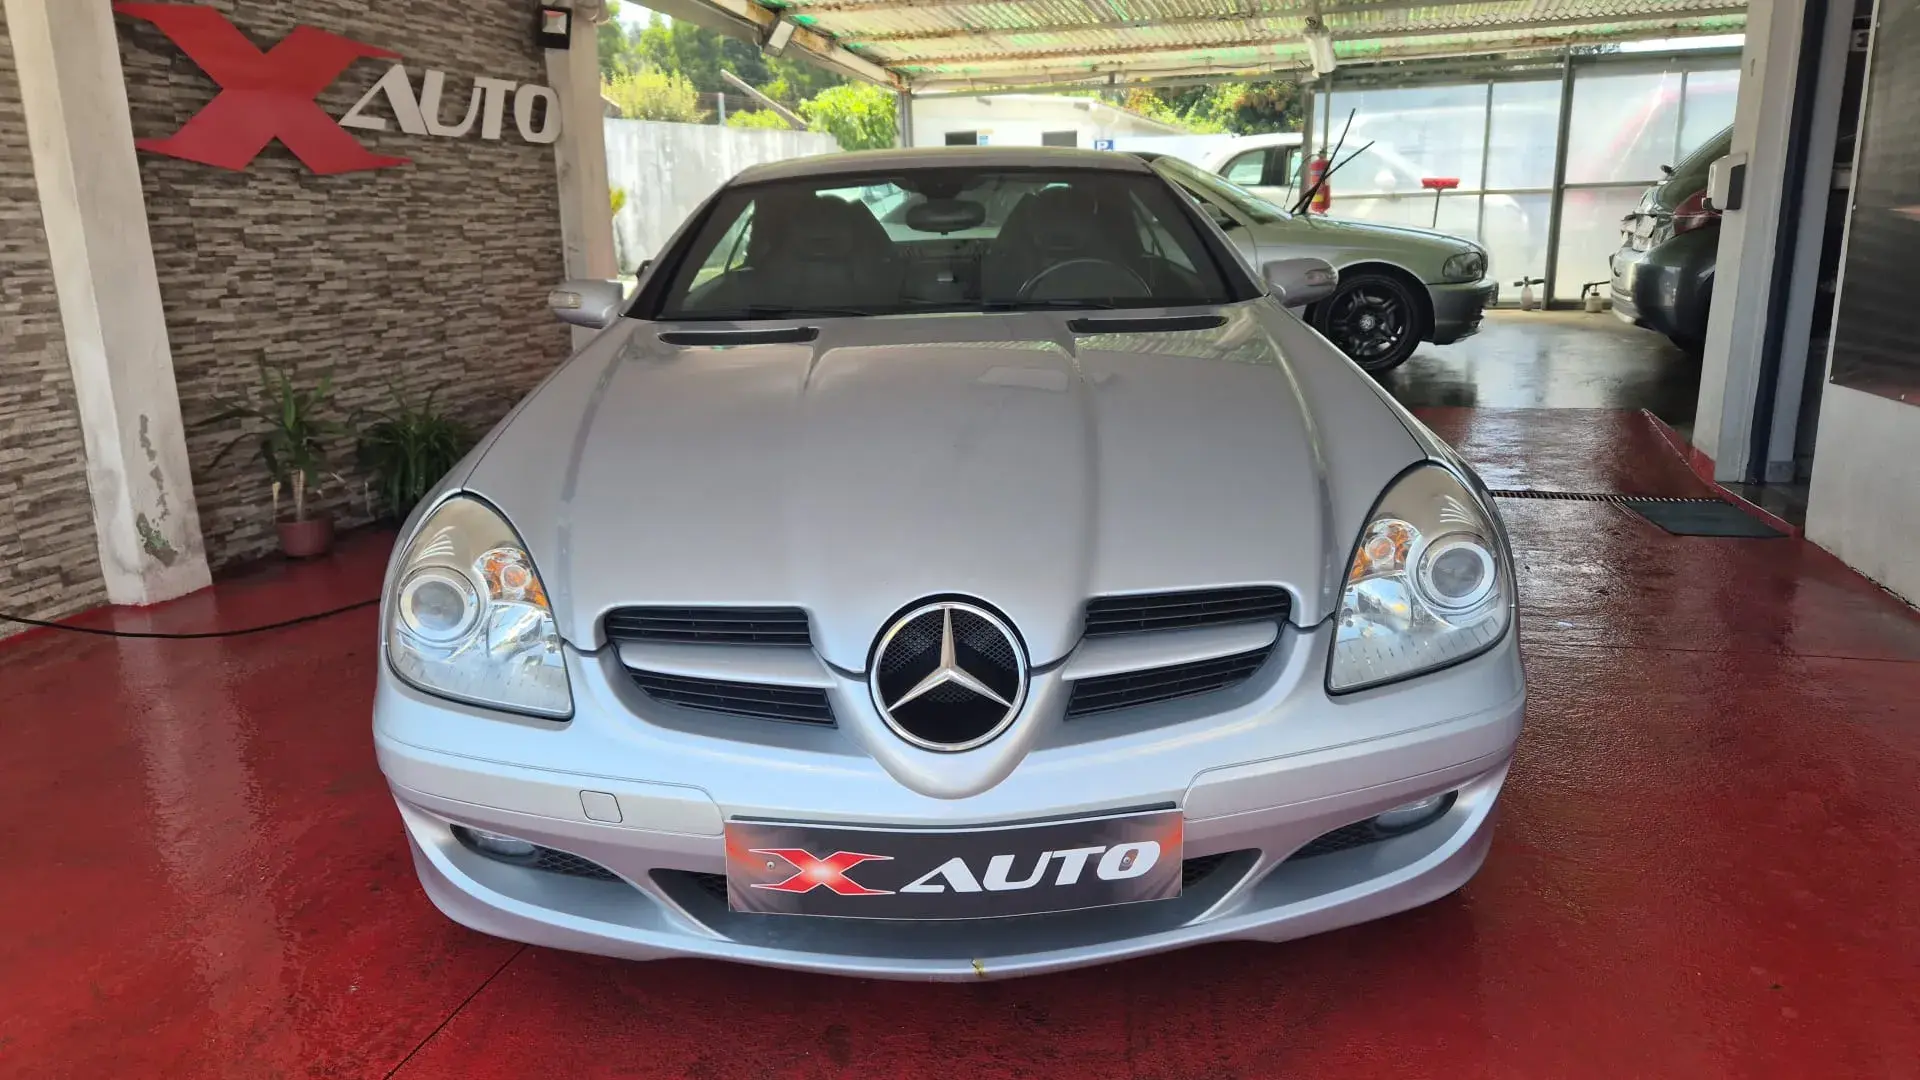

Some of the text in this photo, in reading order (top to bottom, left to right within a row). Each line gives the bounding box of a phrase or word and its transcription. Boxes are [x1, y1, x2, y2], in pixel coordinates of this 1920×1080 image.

[111, 2, 563, 175] X AUTO
[748, 840, 1161, 896] X AUTO
